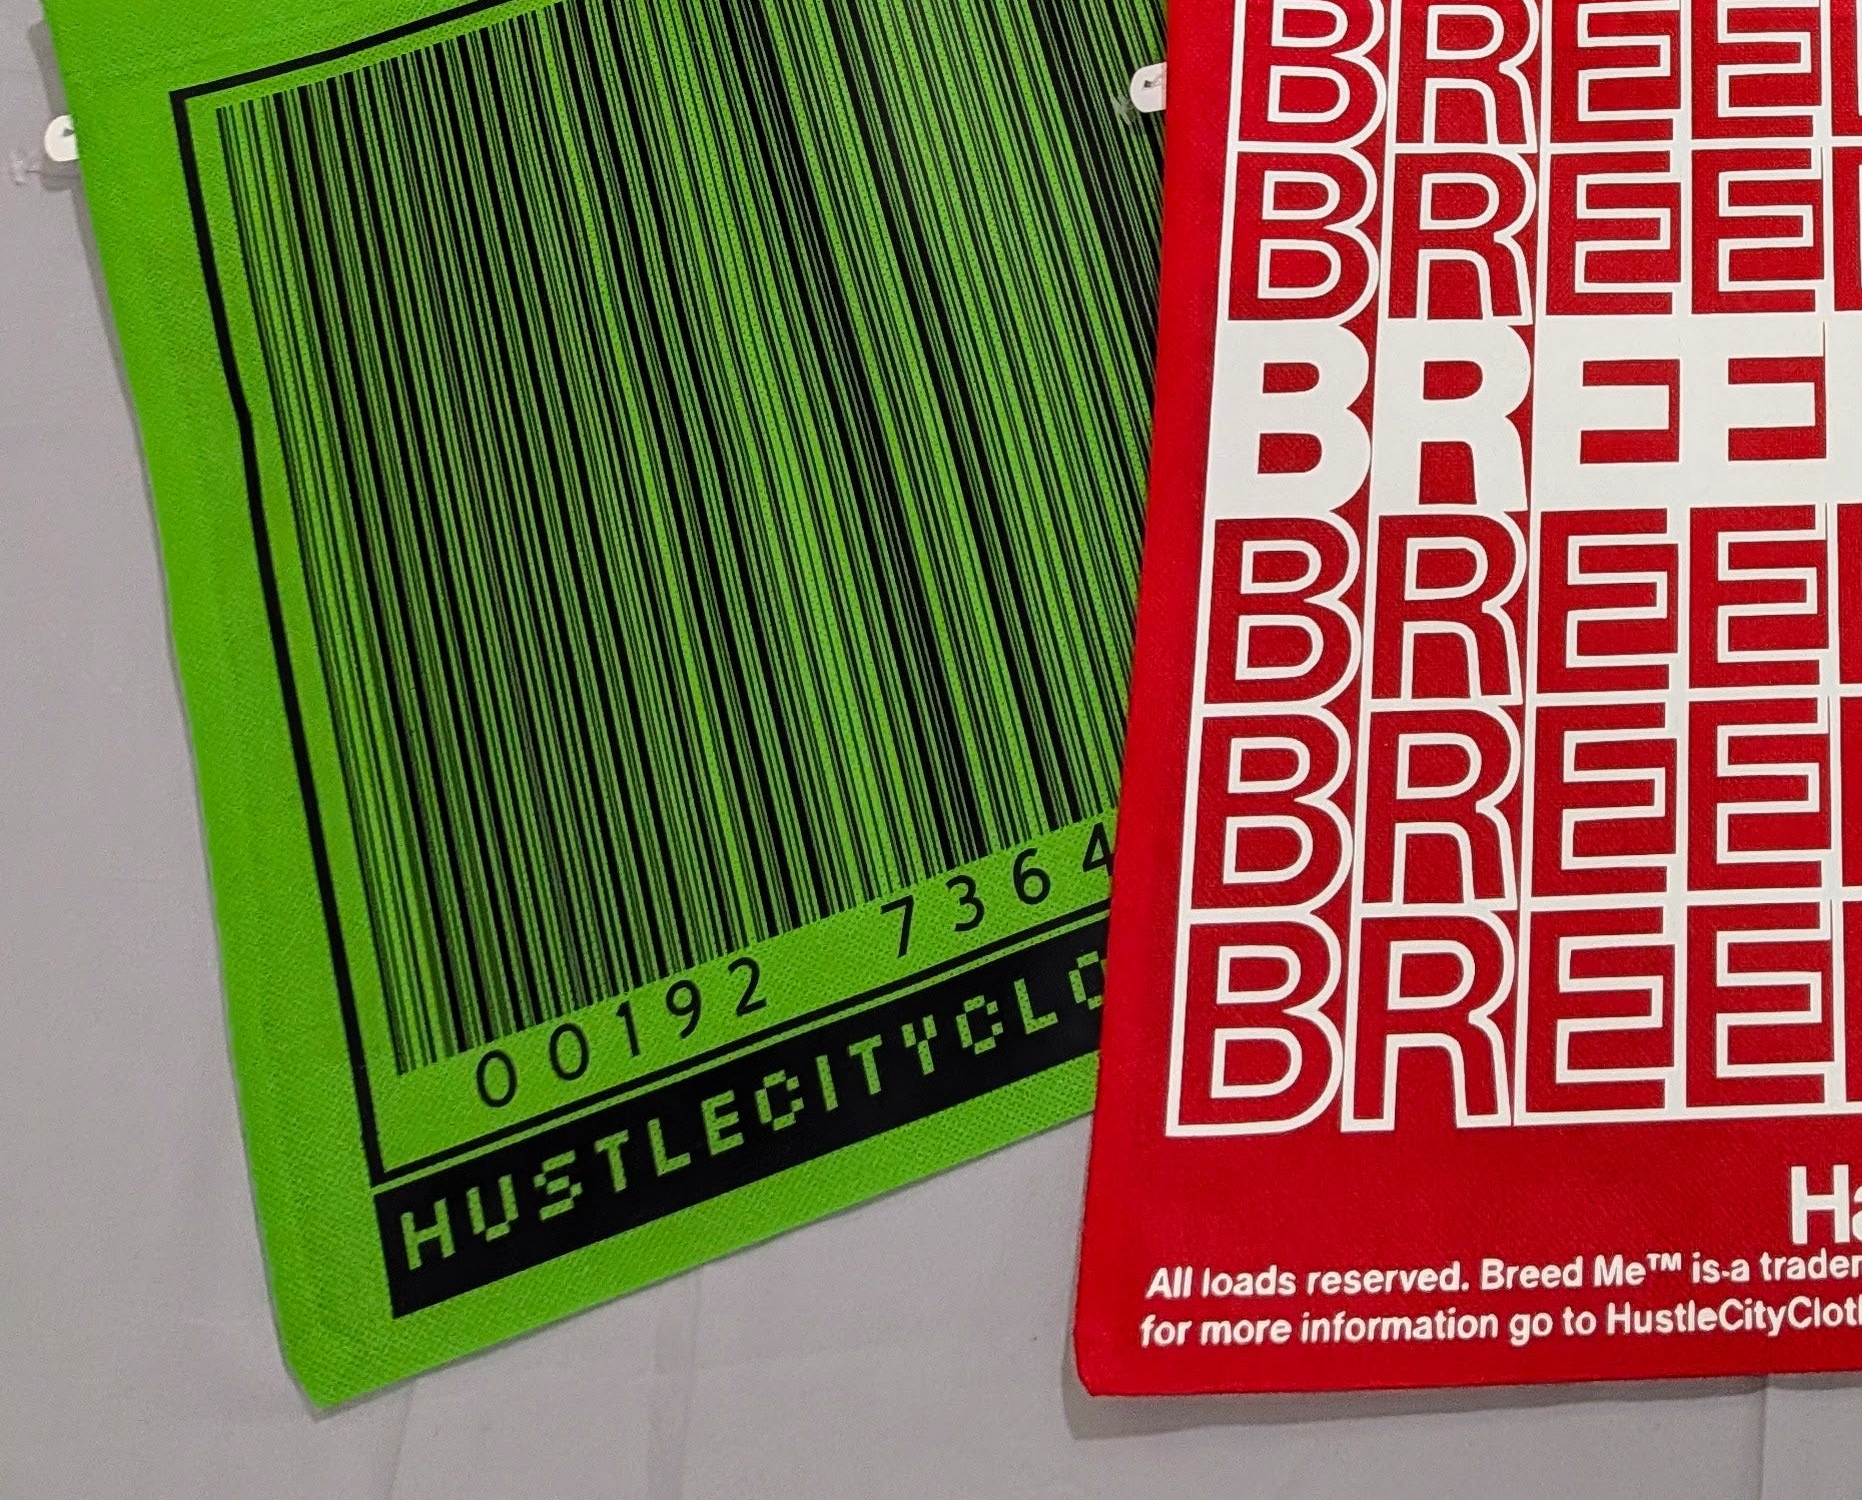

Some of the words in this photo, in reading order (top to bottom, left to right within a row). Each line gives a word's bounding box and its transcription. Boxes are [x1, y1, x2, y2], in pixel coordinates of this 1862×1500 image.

[1146, 1266, 1193, 1299] All
[1201, 1264, 1297, 1298] loads
[1306, 1259, 1470, 1296] reserved.
[1481, 1255, 1584, 1292] Breed
[1140, 1314, 1192, 1347] for
[1200, 1316, 1292, 1345] more
[1301, 1308, 1498, 1343] information
[1509, 1314, 1552, 1347] go
[1562, 1306, 1597, 1337] to
